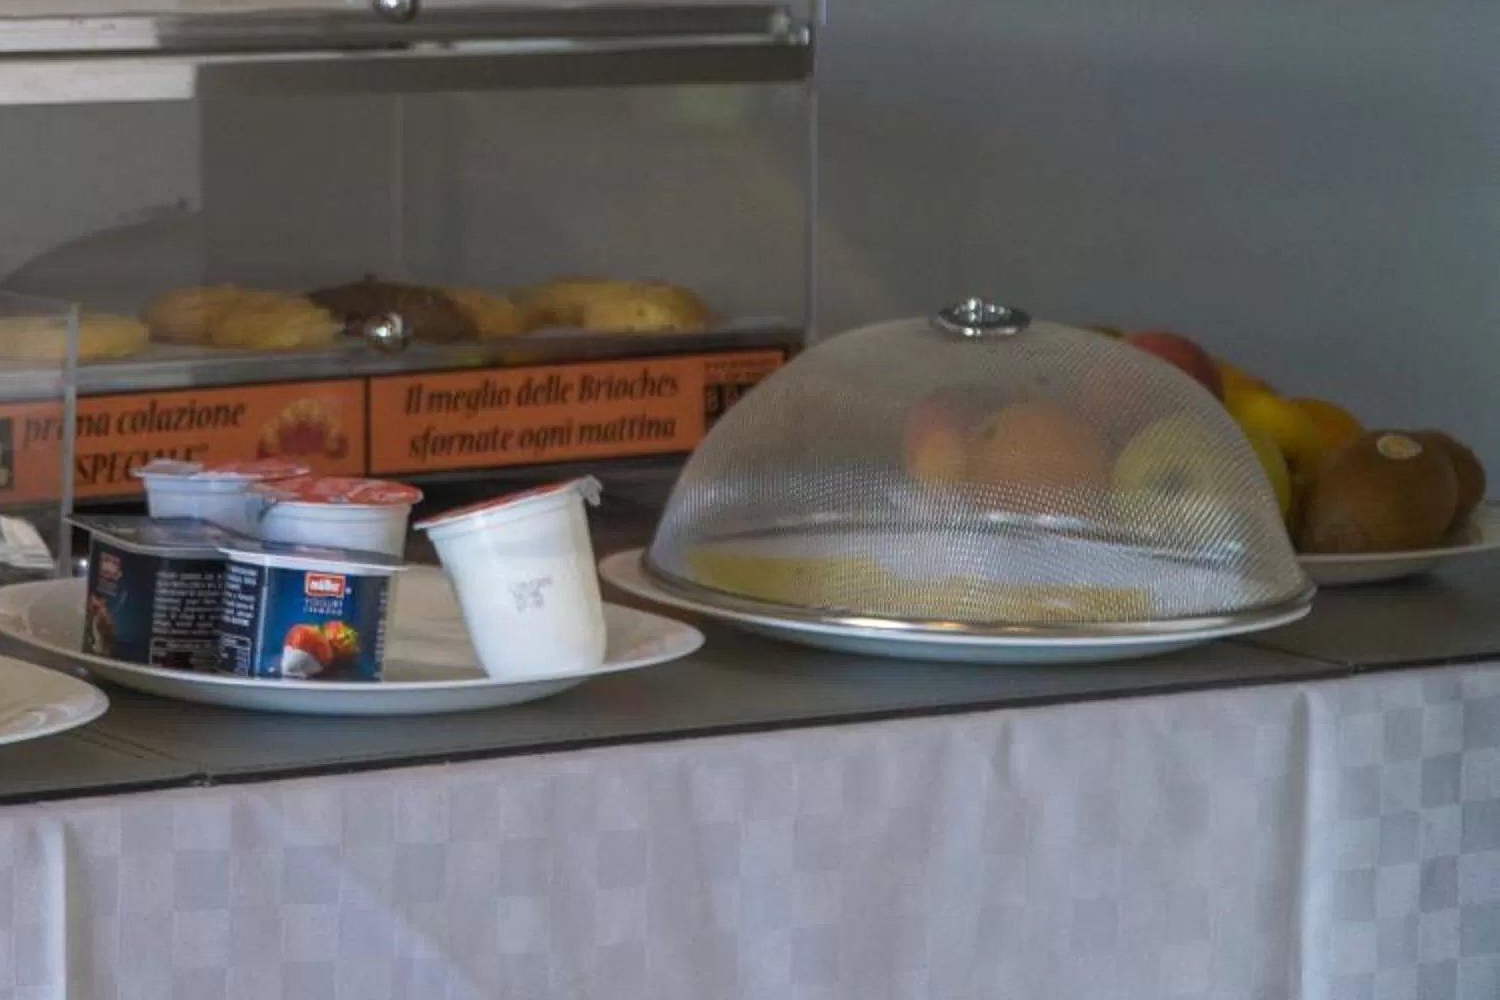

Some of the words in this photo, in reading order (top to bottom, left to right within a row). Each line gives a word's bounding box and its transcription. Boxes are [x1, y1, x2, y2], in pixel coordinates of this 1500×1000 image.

[116, 400, 247, 435] colazione
[403, 383, 424, 417] Il
[426, 378, 512, 419] meglio
[515, 375, 574, 408] delle
[578, 367, 679, 405] Brioches
[407, 424, 514, 463] sfornate
[517, 416, 574, 454] ogni
[578, 412, 677, 445] mattina
